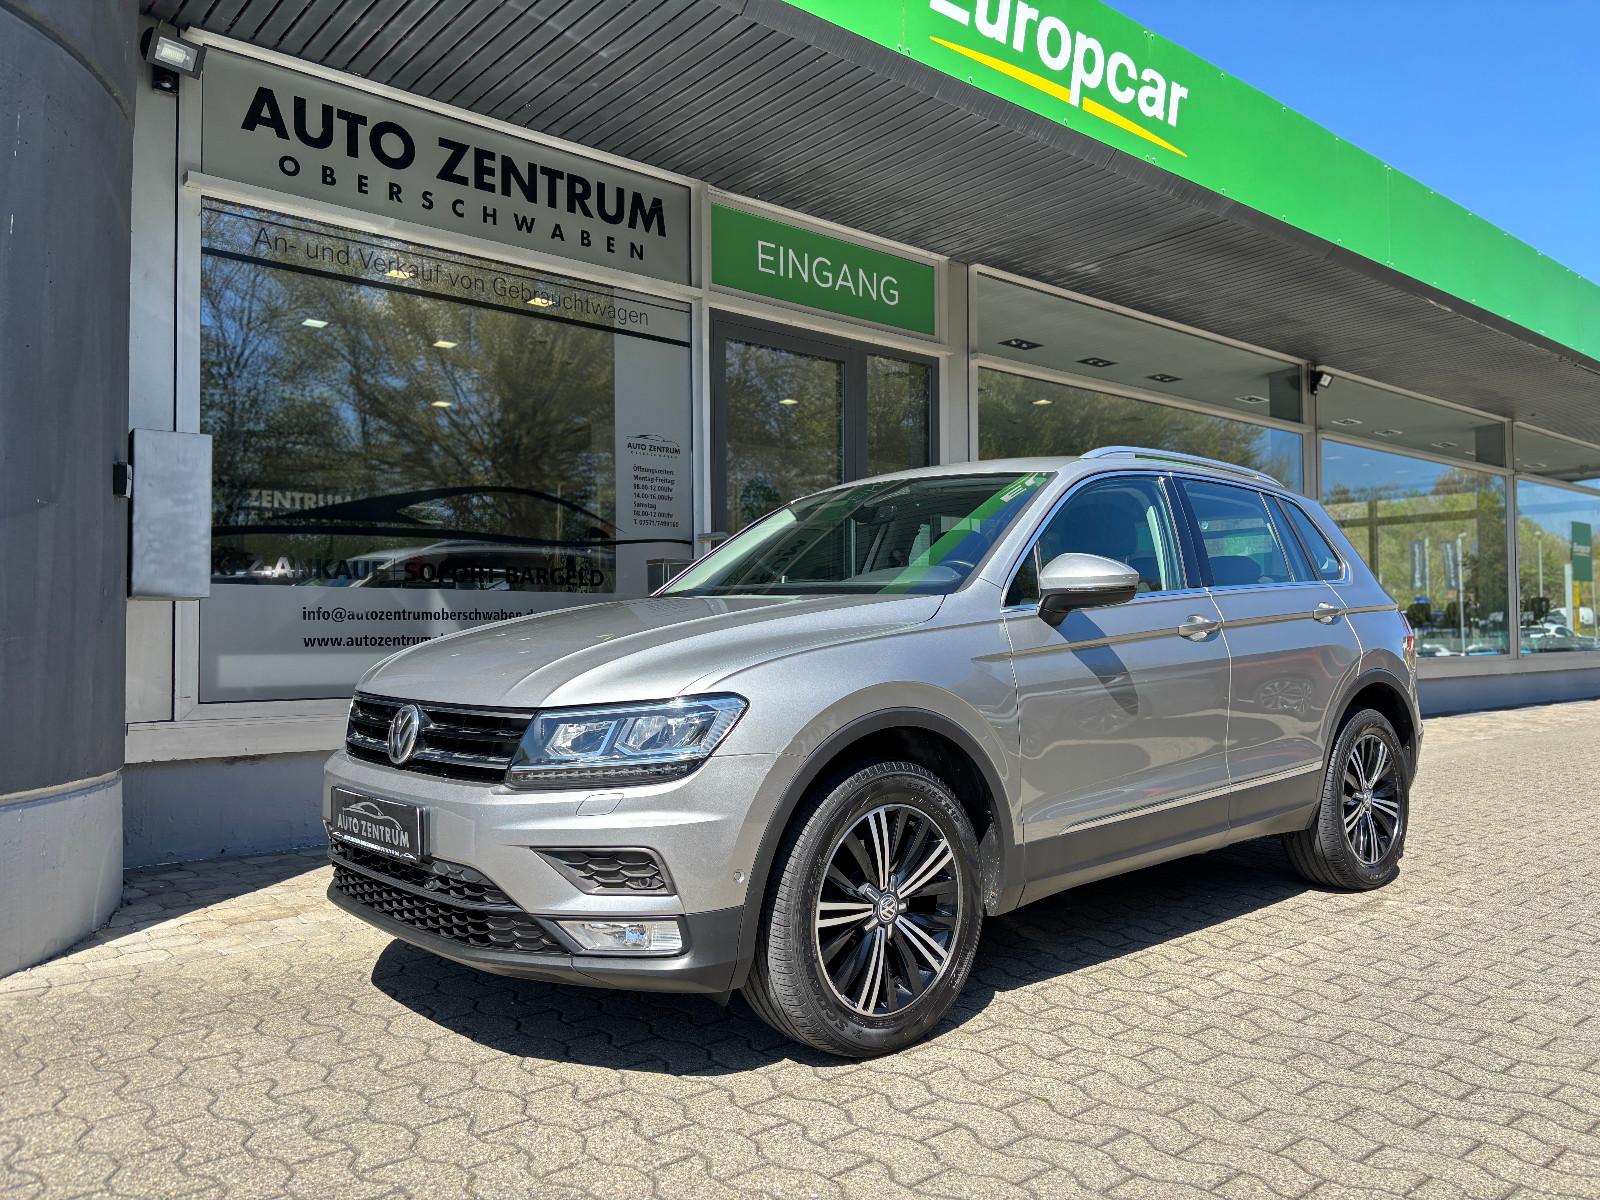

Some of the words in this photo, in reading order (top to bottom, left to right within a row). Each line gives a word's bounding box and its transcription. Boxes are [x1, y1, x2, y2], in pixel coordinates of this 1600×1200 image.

[241, 86, 415, 170] AUTO
[436, 137, 667, 237] ZENTRUM
[278, 155, 644, 260] OBERSCHWABEN
[254, 228, 297, 253] An-
[306, 242, 350, 265] und
[359, 248, 441, 283] Verkauf
[449, 273, 485, 292] von
[493, 278, 648, 325] Gebrauchtwagen
[757, 240, 899, 306] EINGANG
[627, 442, 646, 451] AUTO
[649, 445, 680, 455] ZENTRUM
[505, 567, 605, 588] BARGELD
[303, 607, 533, 622] info@autozentrumoberschwaben
[304, 633, 443, 647] www.autozentrum
[337, 813, 360, 834] AUTO
[361, 821, 410, 848] ZENTRUM
